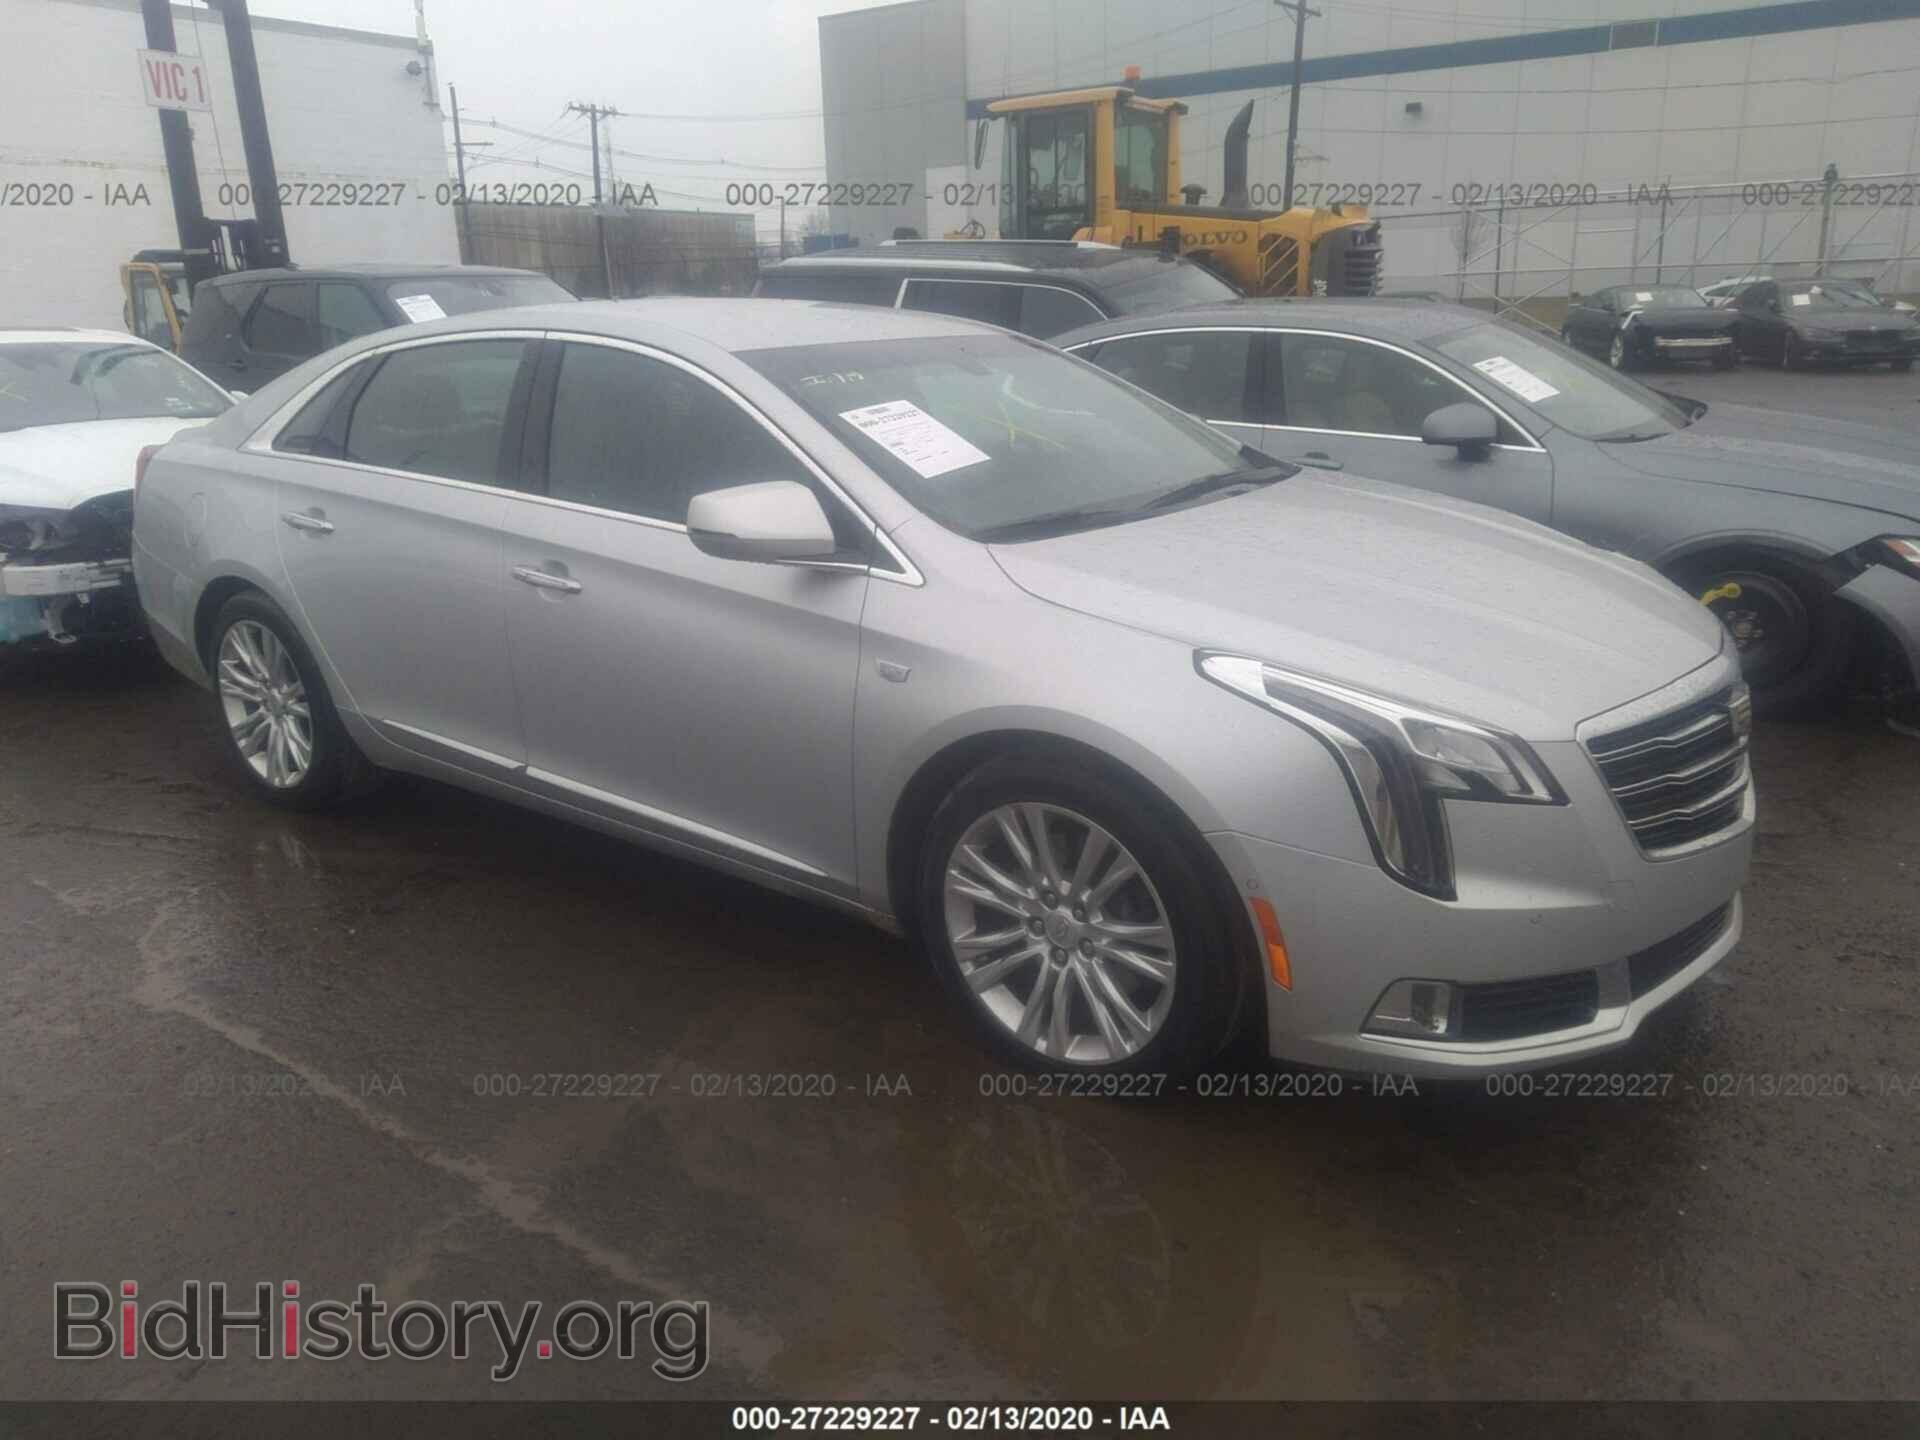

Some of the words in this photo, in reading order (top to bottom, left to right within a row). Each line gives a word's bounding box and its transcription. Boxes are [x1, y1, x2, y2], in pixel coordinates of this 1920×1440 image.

[146, 59, 187, 101] VIC
[192, 65, 204, 102] 1
[1180, 230, 1249, 247] OLVO
